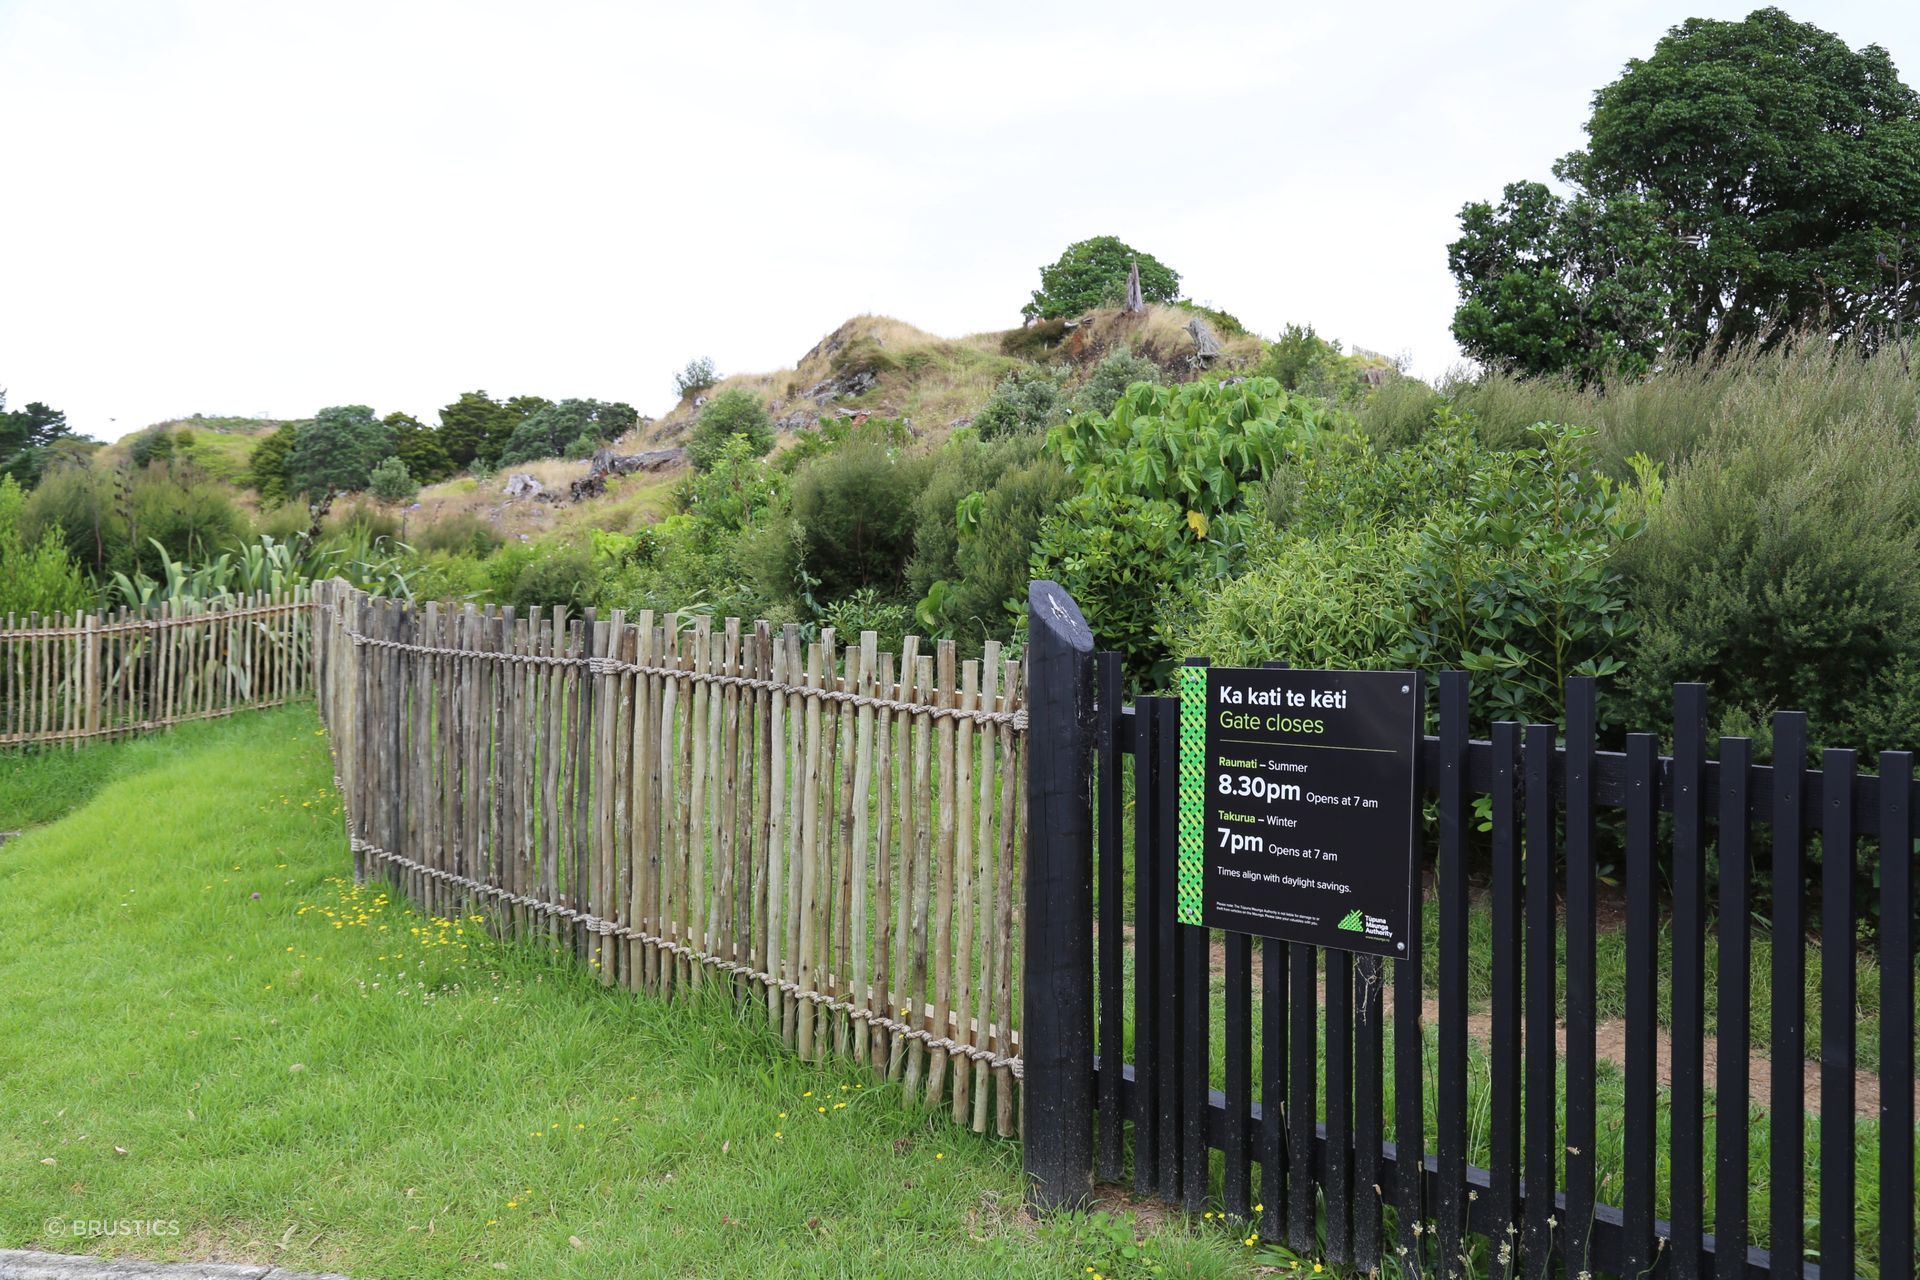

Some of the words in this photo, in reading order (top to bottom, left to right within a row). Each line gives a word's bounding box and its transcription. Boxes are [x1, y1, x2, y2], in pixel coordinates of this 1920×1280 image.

[1220, 685, 1242, 704] Ka
[1248, 687, 1281, 706] kati
[1286, 689, 1305, 707] te
[1311, 689, 1347, 709] kēti
[1220, 710, 1261, 730] Gate
[1266, 713, 1324, 734] closes
[1219, 756, 1257, 769] Raumati
[1268, 760, 1308, 773] Summer
[1218, 774, 1301, 804] 8.30pm
[1306, 792, 1339, 805] Opens
[1341, 796, 1351, 806] at
[1353, 796, 1360, 806] 7
[1362, 799, 1378, 808] am
[1218, 810, 1256, 823] Takurua
[1266, 815, 1297, 828] Winter
[1217, 827, 1263, 854] 7pm
[1268, 844, 1300, 857] Opens
[1302, 849, 1312, 859] at
[1314, 849, 1320, 859] 7
[1322, 852, 1338, 861] am
[1217, 866, 1241, 878] Times
[1242, 870, 1262, 882] align
[1263, 873, 1280, 883] with
[1282, 875, 1315, 889] daylight
[1317, 881, 1352, 894] savings.
[1365, 927, 1393, 938] Authority
